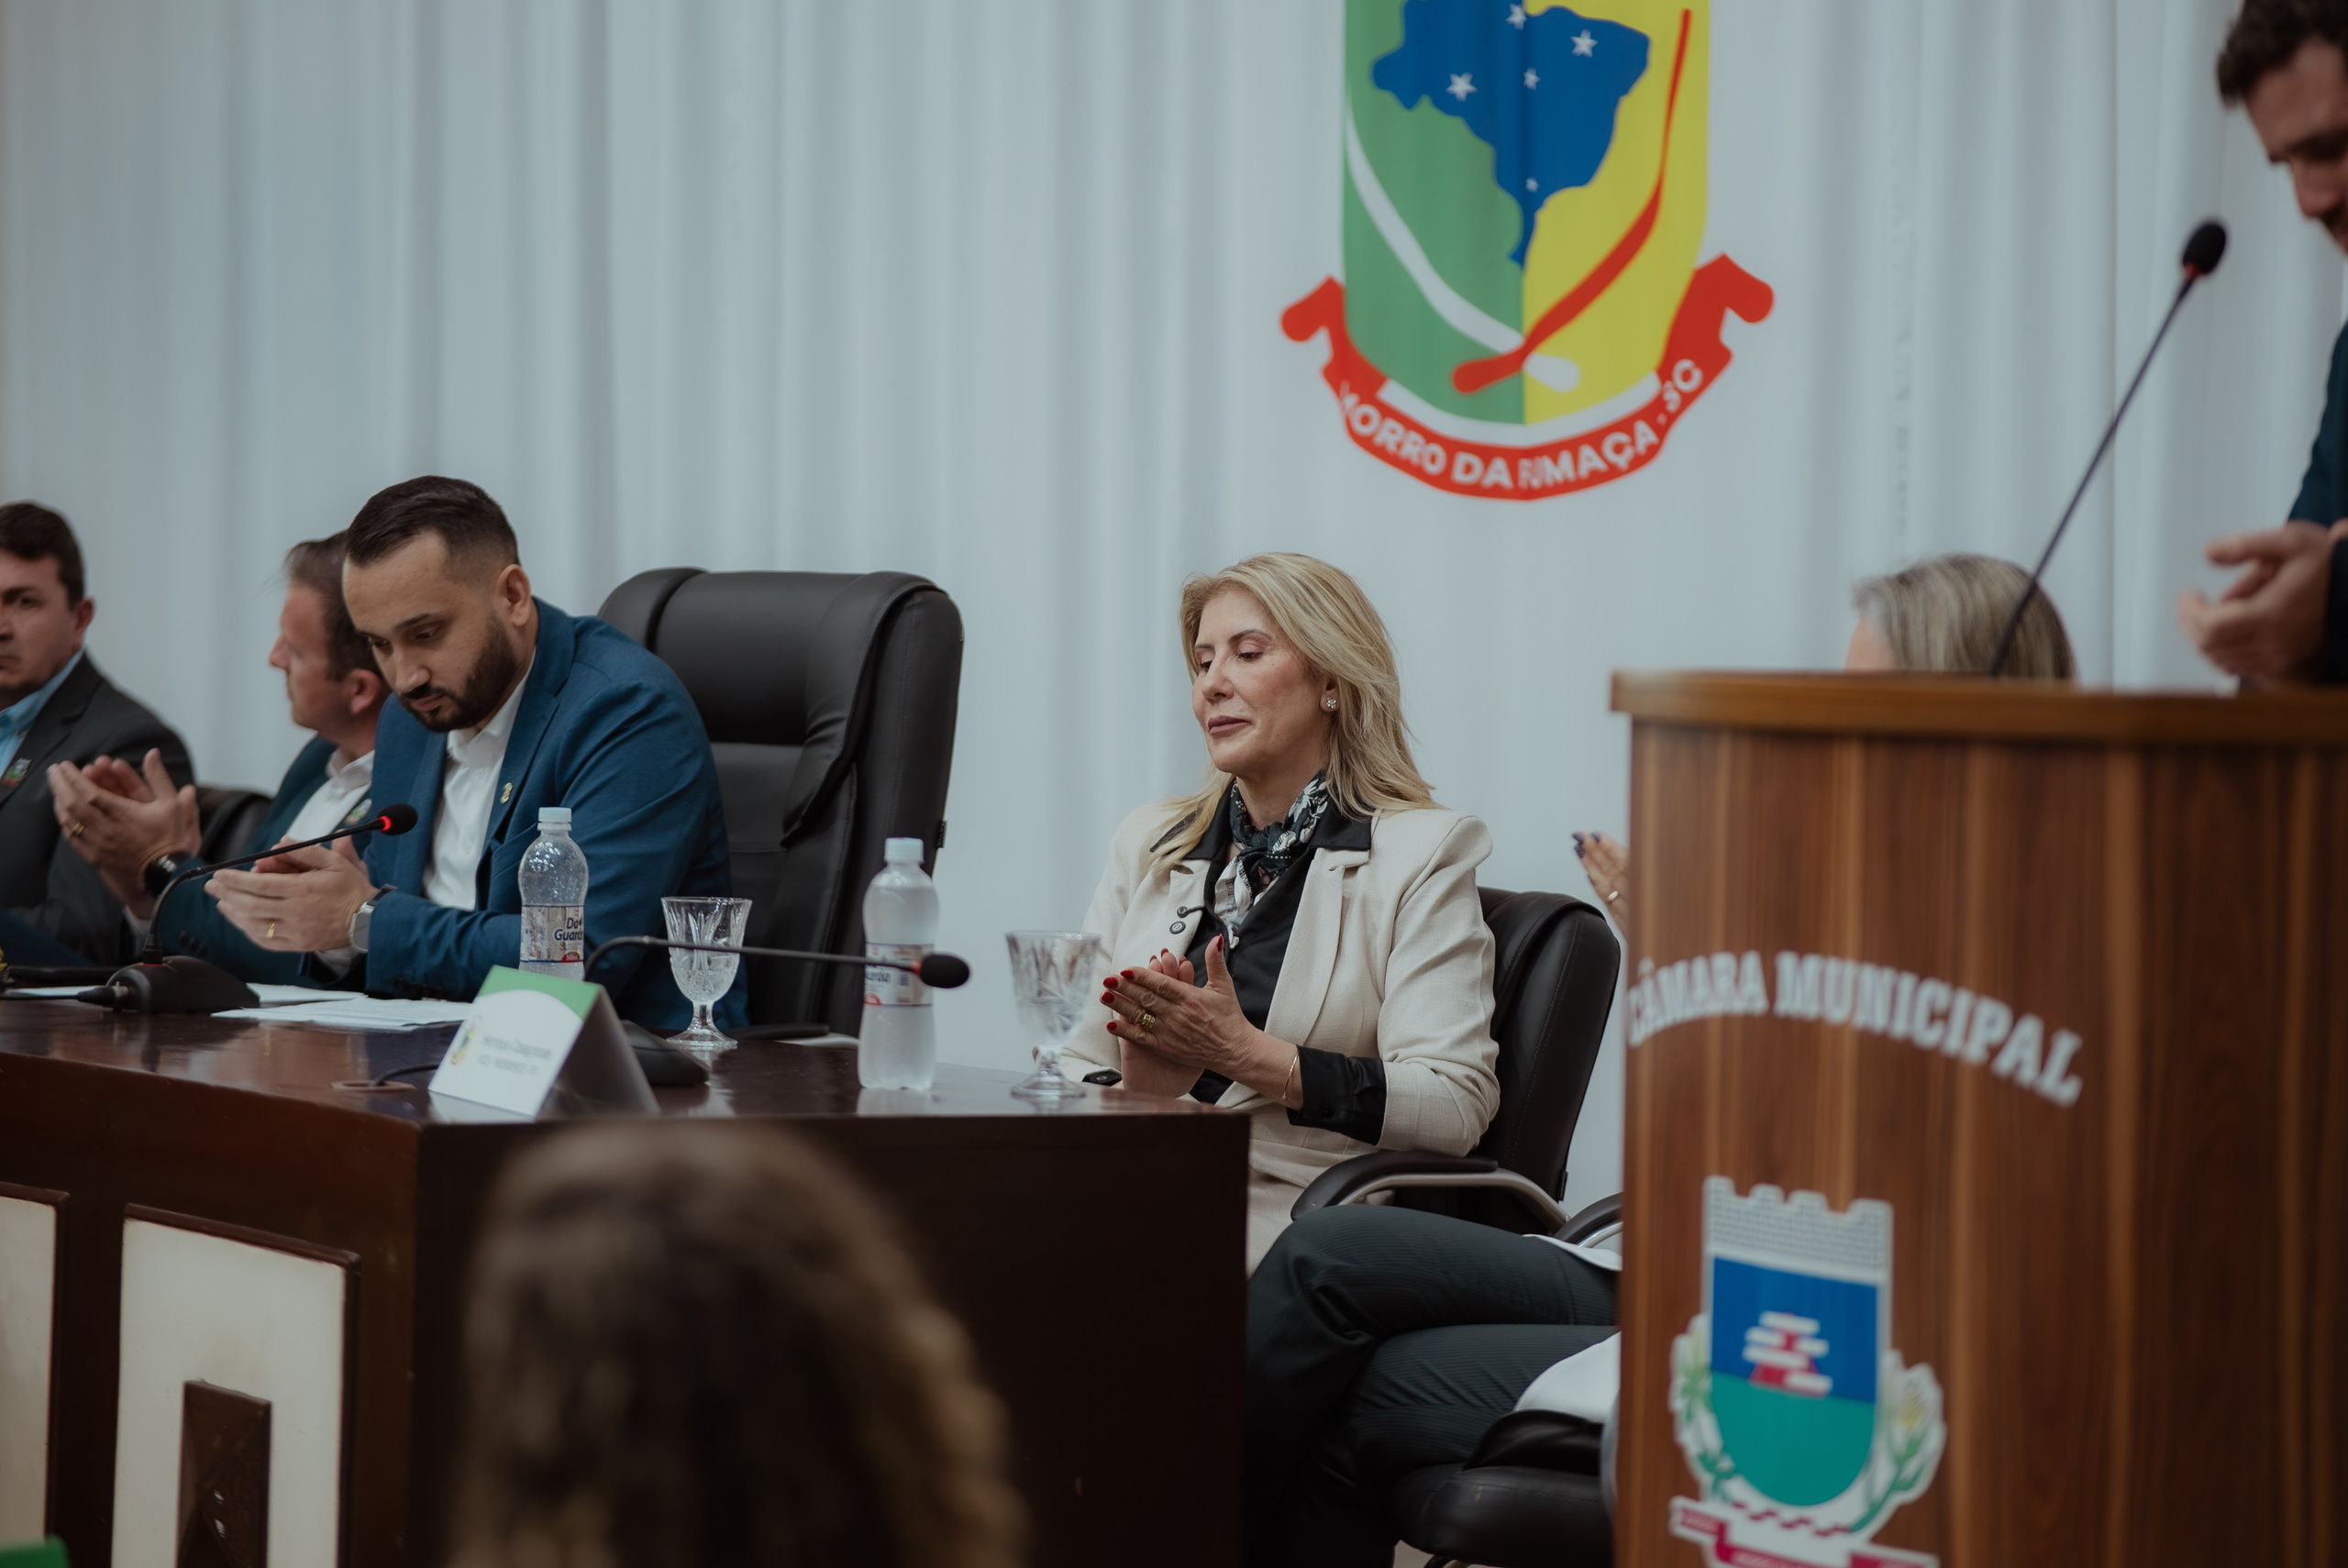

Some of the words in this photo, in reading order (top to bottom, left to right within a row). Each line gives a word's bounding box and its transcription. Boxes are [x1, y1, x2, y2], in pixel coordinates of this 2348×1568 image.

[1451, 451, 1513, 490] DA
[566, 917, 579, 930] Da
[1774, 950, 2084, 1107] MUNICIPAL
